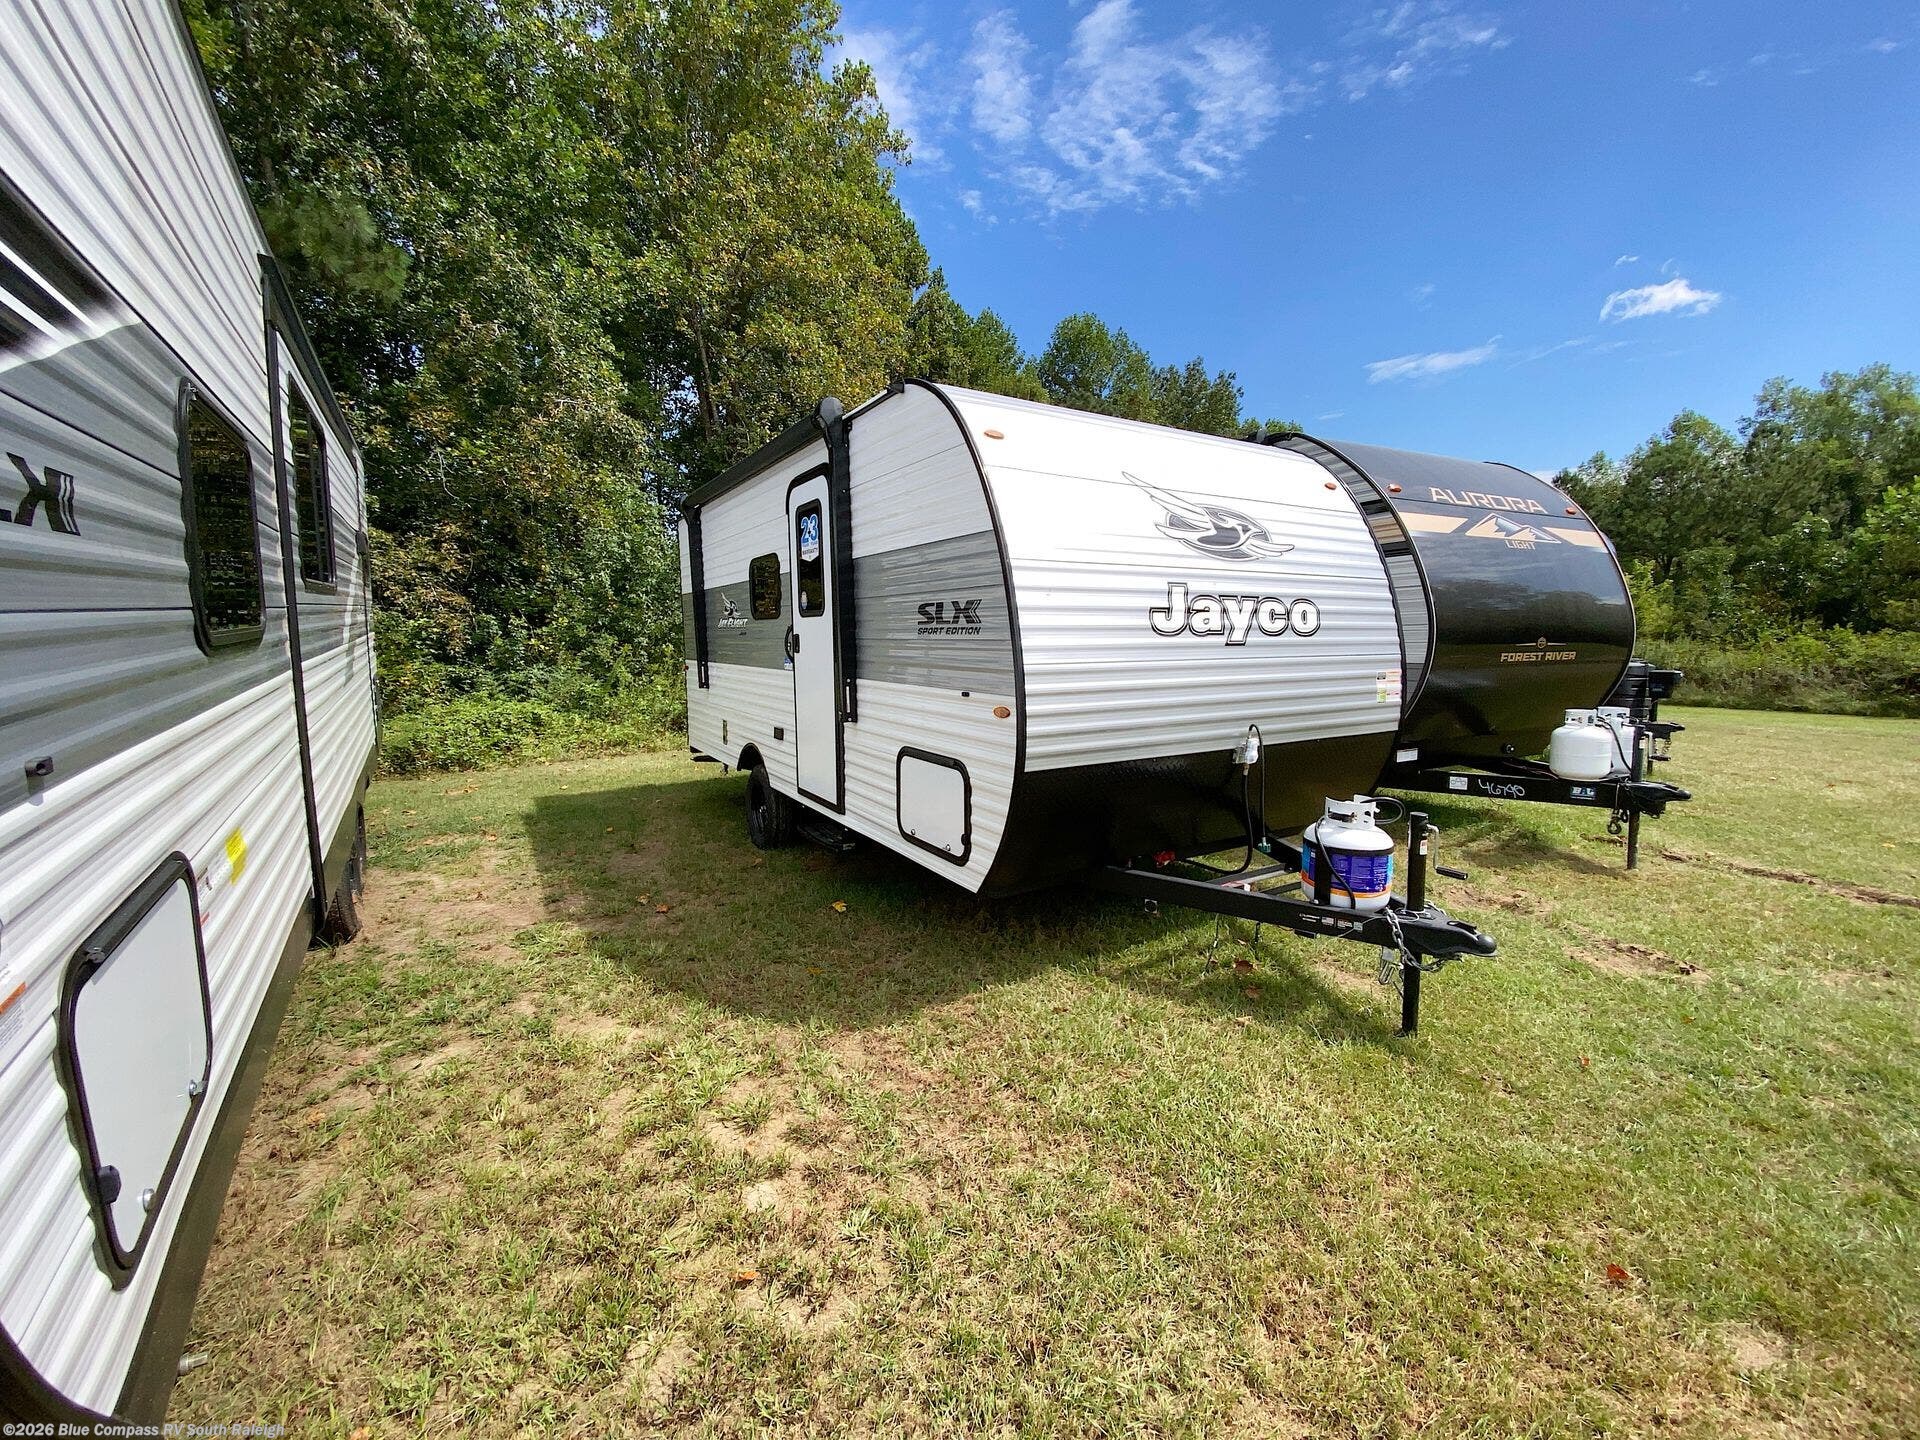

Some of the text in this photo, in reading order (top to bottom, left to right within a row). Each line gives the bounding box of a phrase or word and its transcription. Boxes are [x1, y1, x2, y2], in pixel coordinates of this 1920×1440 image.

[1428, 486, 1548, 514] AURORA
[1505, 540, 1536, 550] LIGHT
[917, 599, 982, 625] SLX
[1149, 582, 1321, 646] Jayco
[917, 626, 982, 635] SPORT EDITION
[1500, 651, 1576, 662] FOREST RIVER
